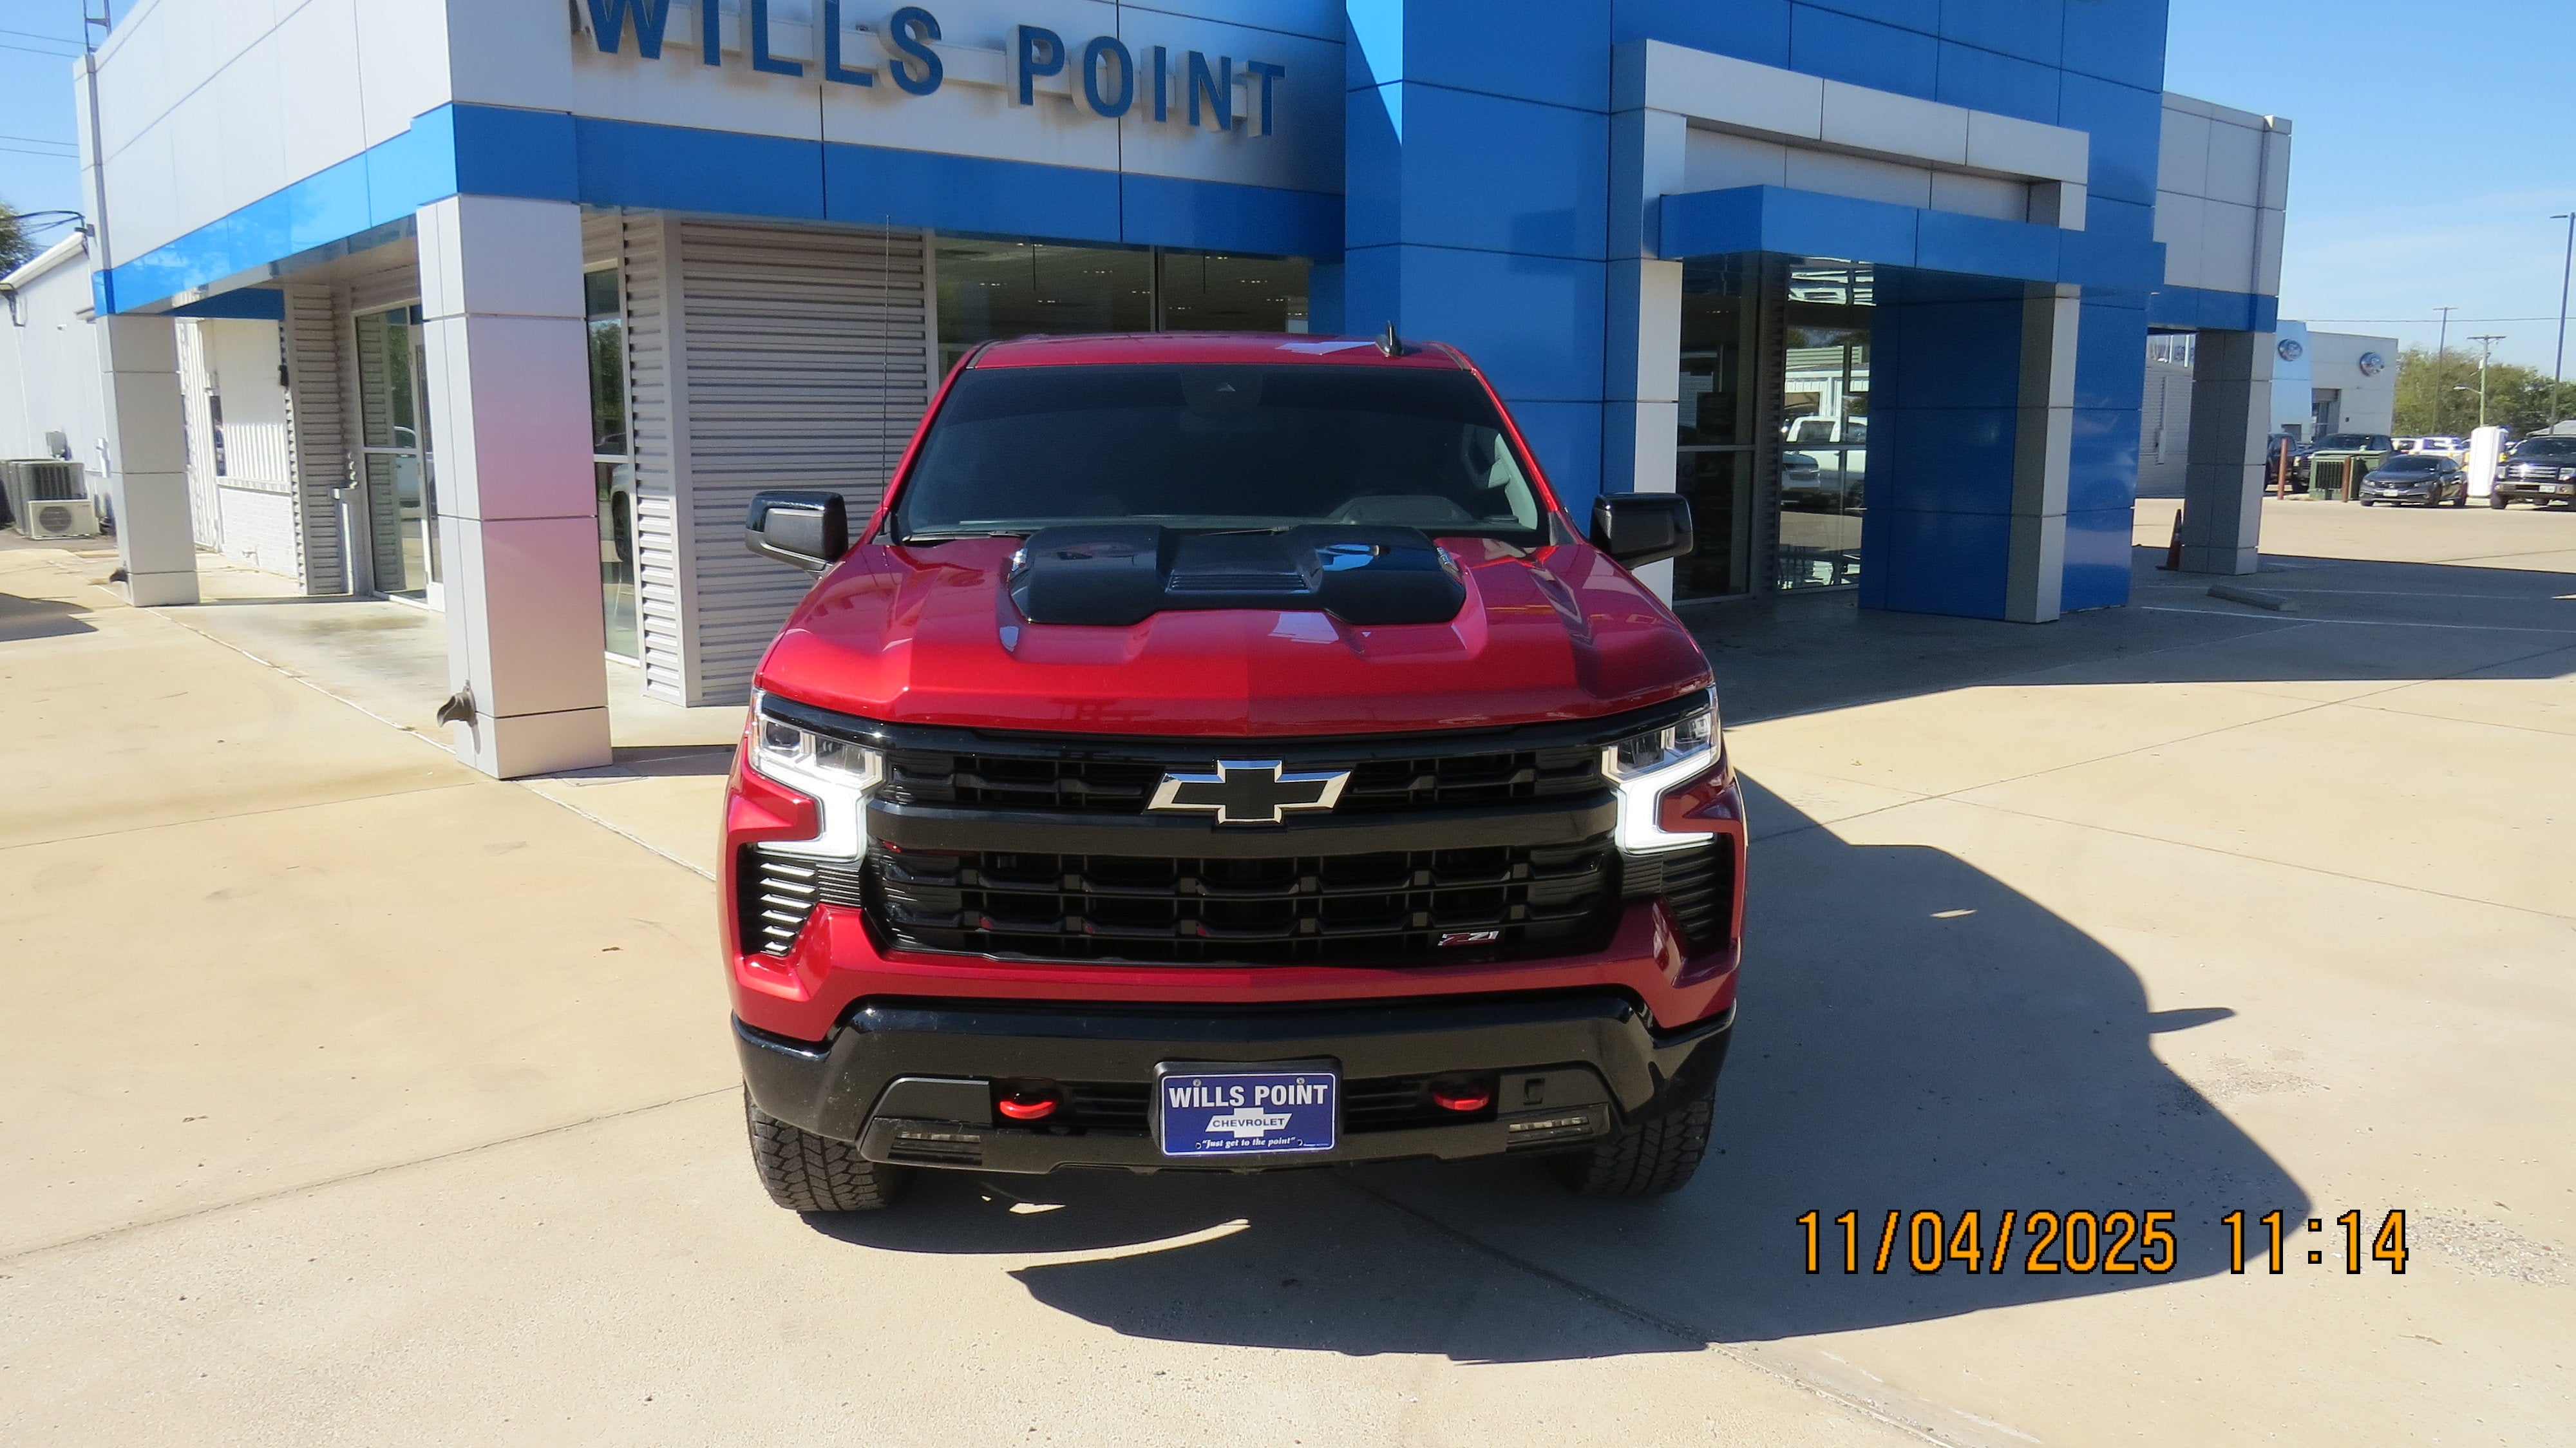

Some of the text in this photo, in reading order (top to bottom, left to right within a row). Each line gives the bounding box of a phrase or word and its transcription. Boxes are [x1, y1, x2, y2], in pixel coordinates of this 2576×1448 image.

[583, 0, 1286, 137] WILLS POINT
[1168, 1083, 1329, 1108] WILLS POINT
[1213, 1118, 1285, 1128] CHEVROLET
[1225, 1139, 1238, 1149] get
[1252, 1138, 1266, 1146] the
